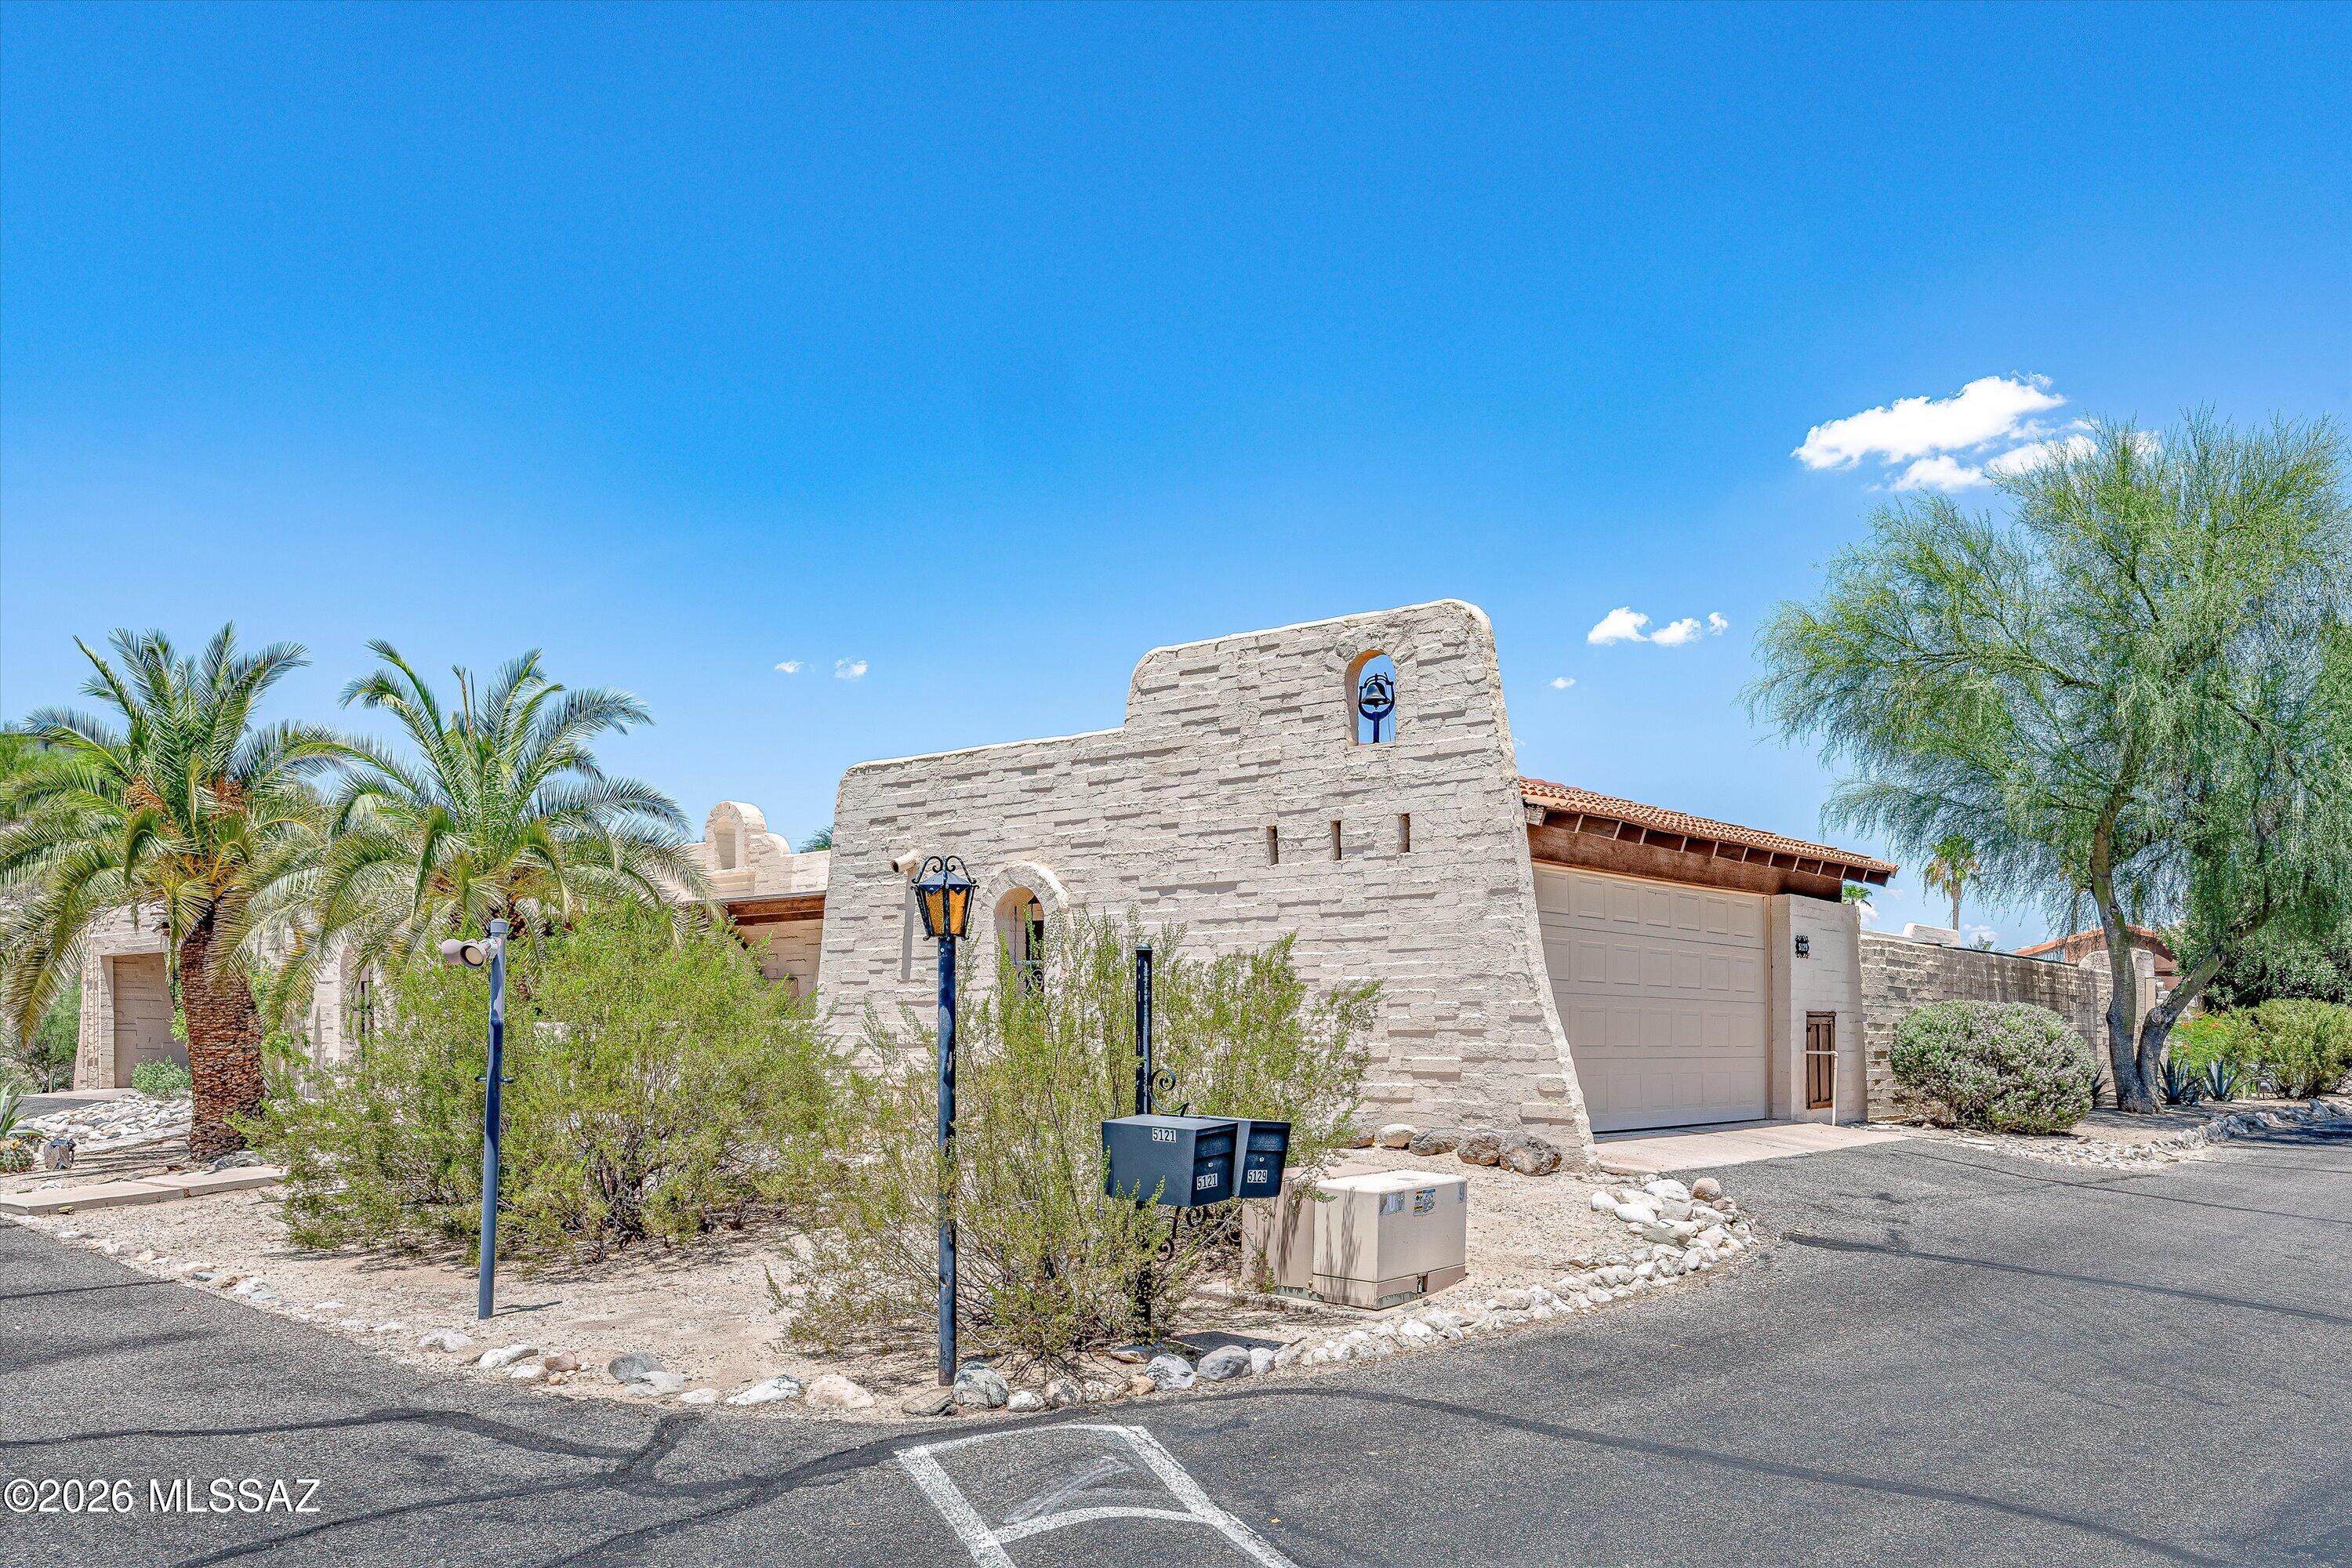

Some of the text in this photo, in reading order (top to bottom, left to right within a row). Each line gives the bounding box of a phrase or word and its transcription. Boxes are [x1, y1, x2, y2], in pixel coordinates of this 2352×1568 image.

[1152, 1128, 1175, 1142] 5121
[1197, 1174, 1218, 1189] 5121
[1248, 1171, 1267, 1182] 5129
